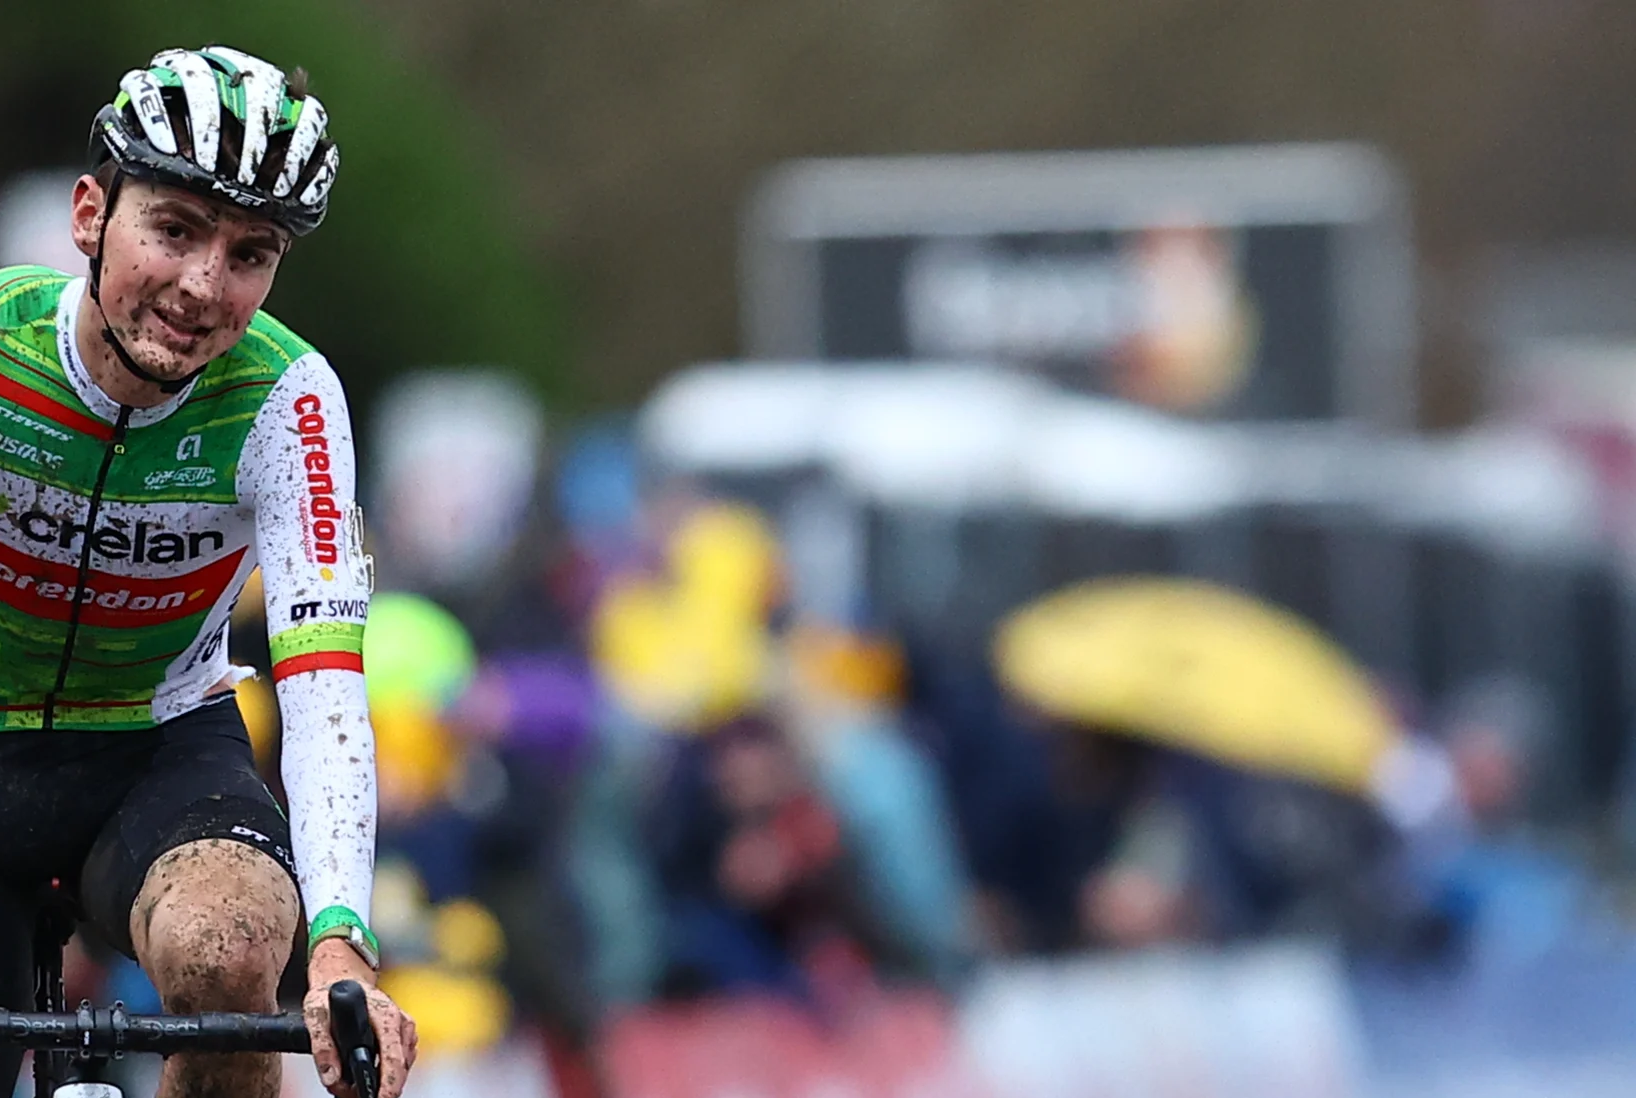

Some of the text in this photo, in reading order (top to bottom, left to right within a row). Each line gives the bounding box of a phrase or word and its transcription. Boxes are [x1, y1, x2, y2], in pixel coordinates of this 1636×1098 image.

[133, 72, 169, 130] MET
[212, 180, 267, 206] MET
[294, 393, 342, 565] corendon
[290, 600, 322, 621] DT
[230, 825, 271, 842] DT
